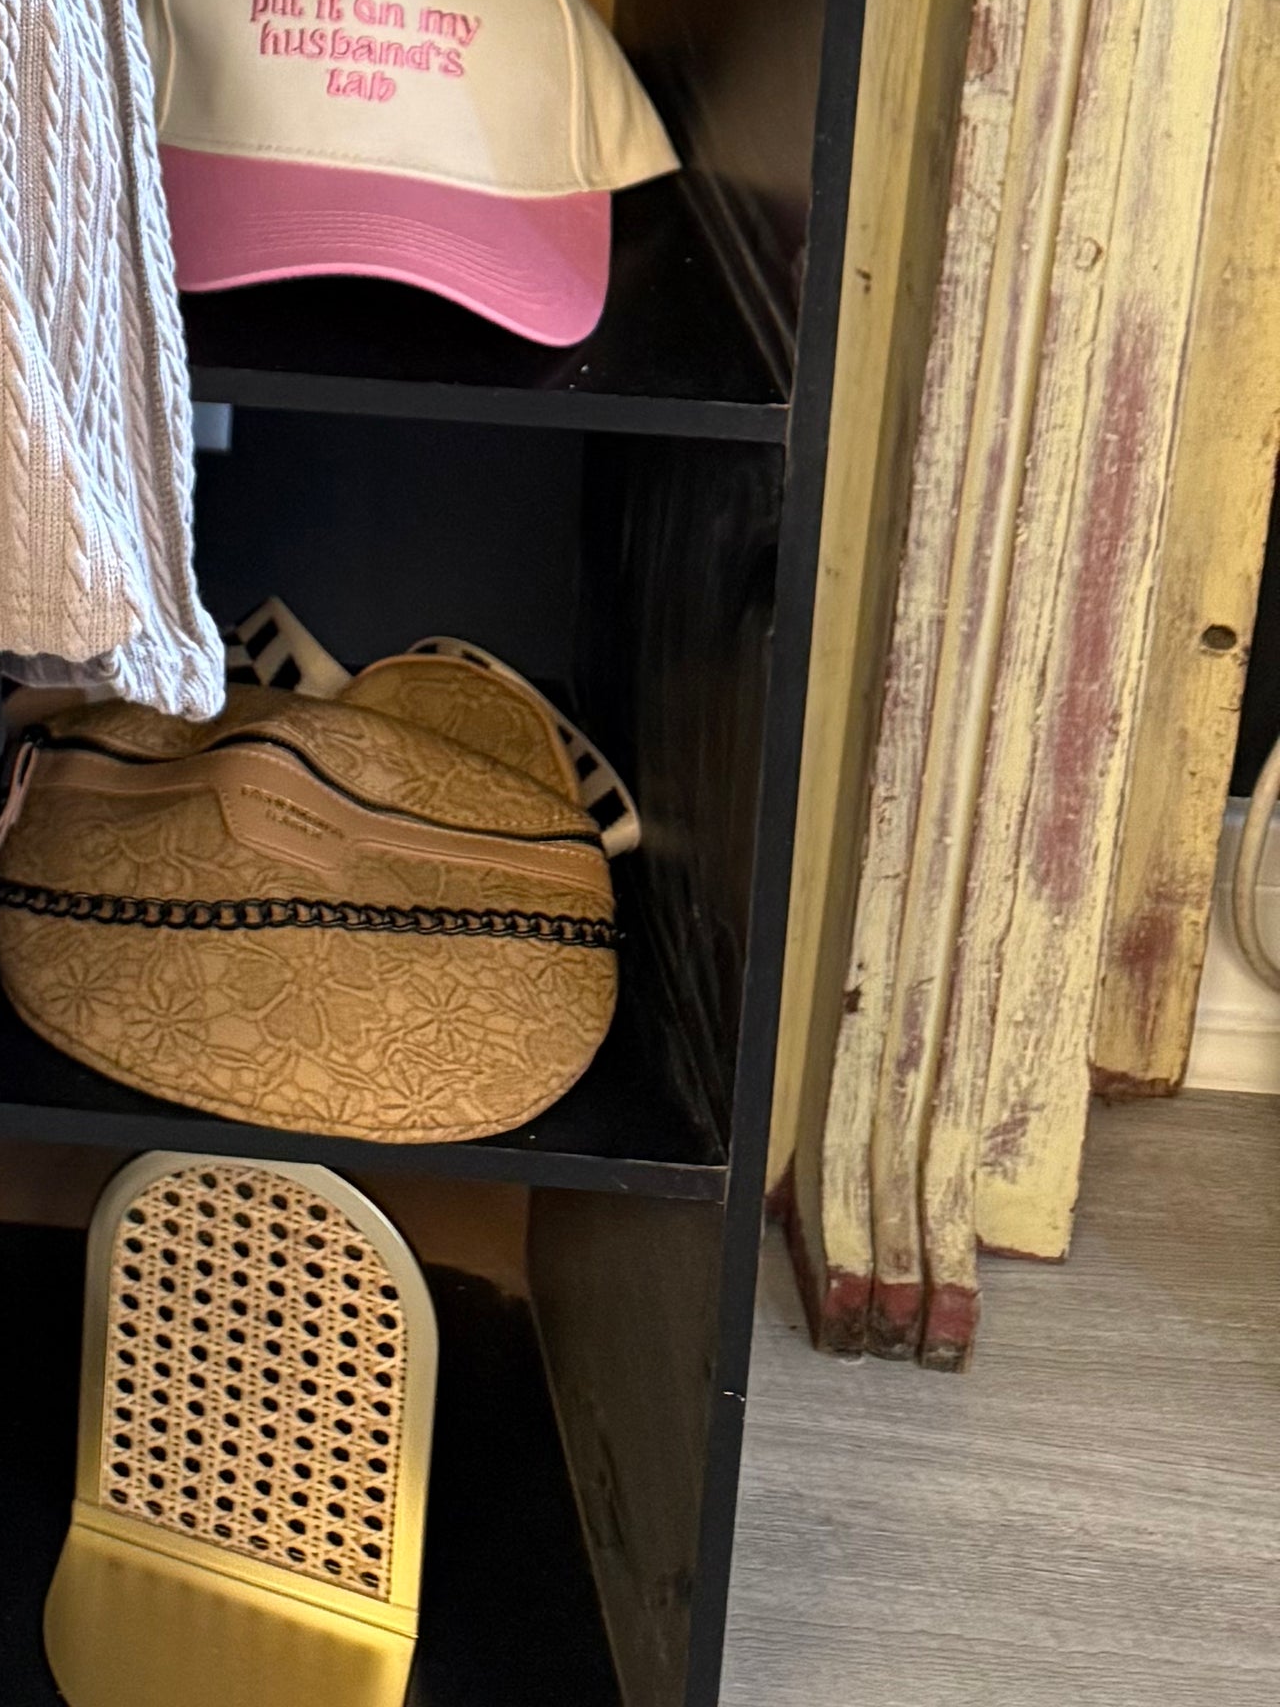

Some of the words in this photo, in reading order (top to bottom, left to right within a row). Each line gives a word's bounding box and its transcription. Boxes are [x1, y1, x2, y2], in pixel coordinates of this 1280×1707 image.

[419, 6, 482, 47] my
[258, 20, 465, 77] husband's
[325, 67, 397, 102] tab
